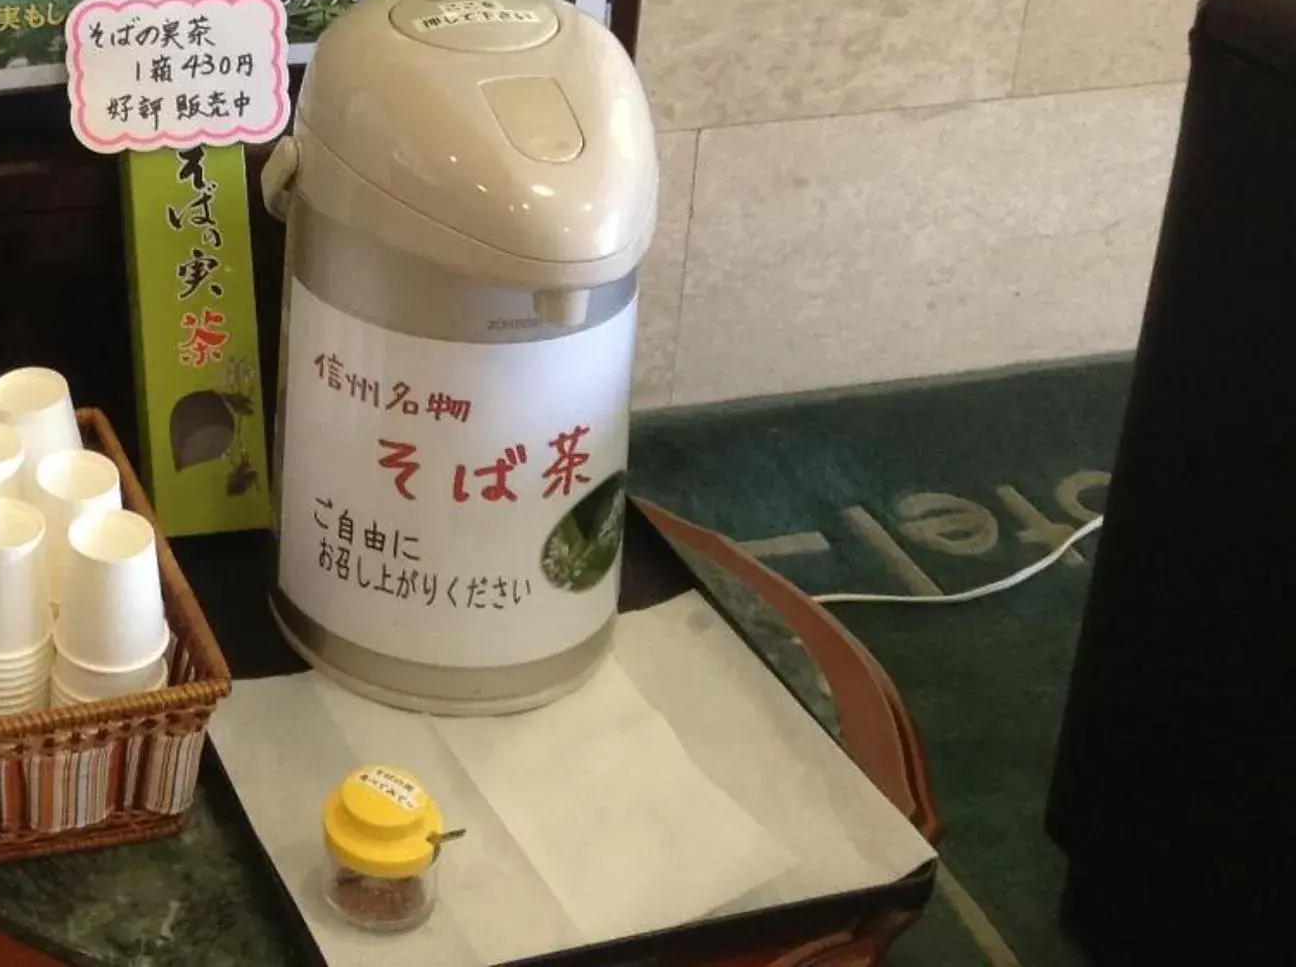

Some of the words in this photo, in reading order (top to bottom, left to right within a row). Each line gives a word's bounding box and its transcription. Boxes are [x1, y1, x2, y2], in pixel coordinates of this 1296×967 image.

[88, 15, 216, 50] そばの実茶
[167, 146, 229, 366] そばの実茶
[314, 352, 471, 422] 信州名物
[378, 426, 591, 503] そば茶
[313, 497, 421, 562] ご自由に
[317, 540, 532, 609] お召し上がりください
